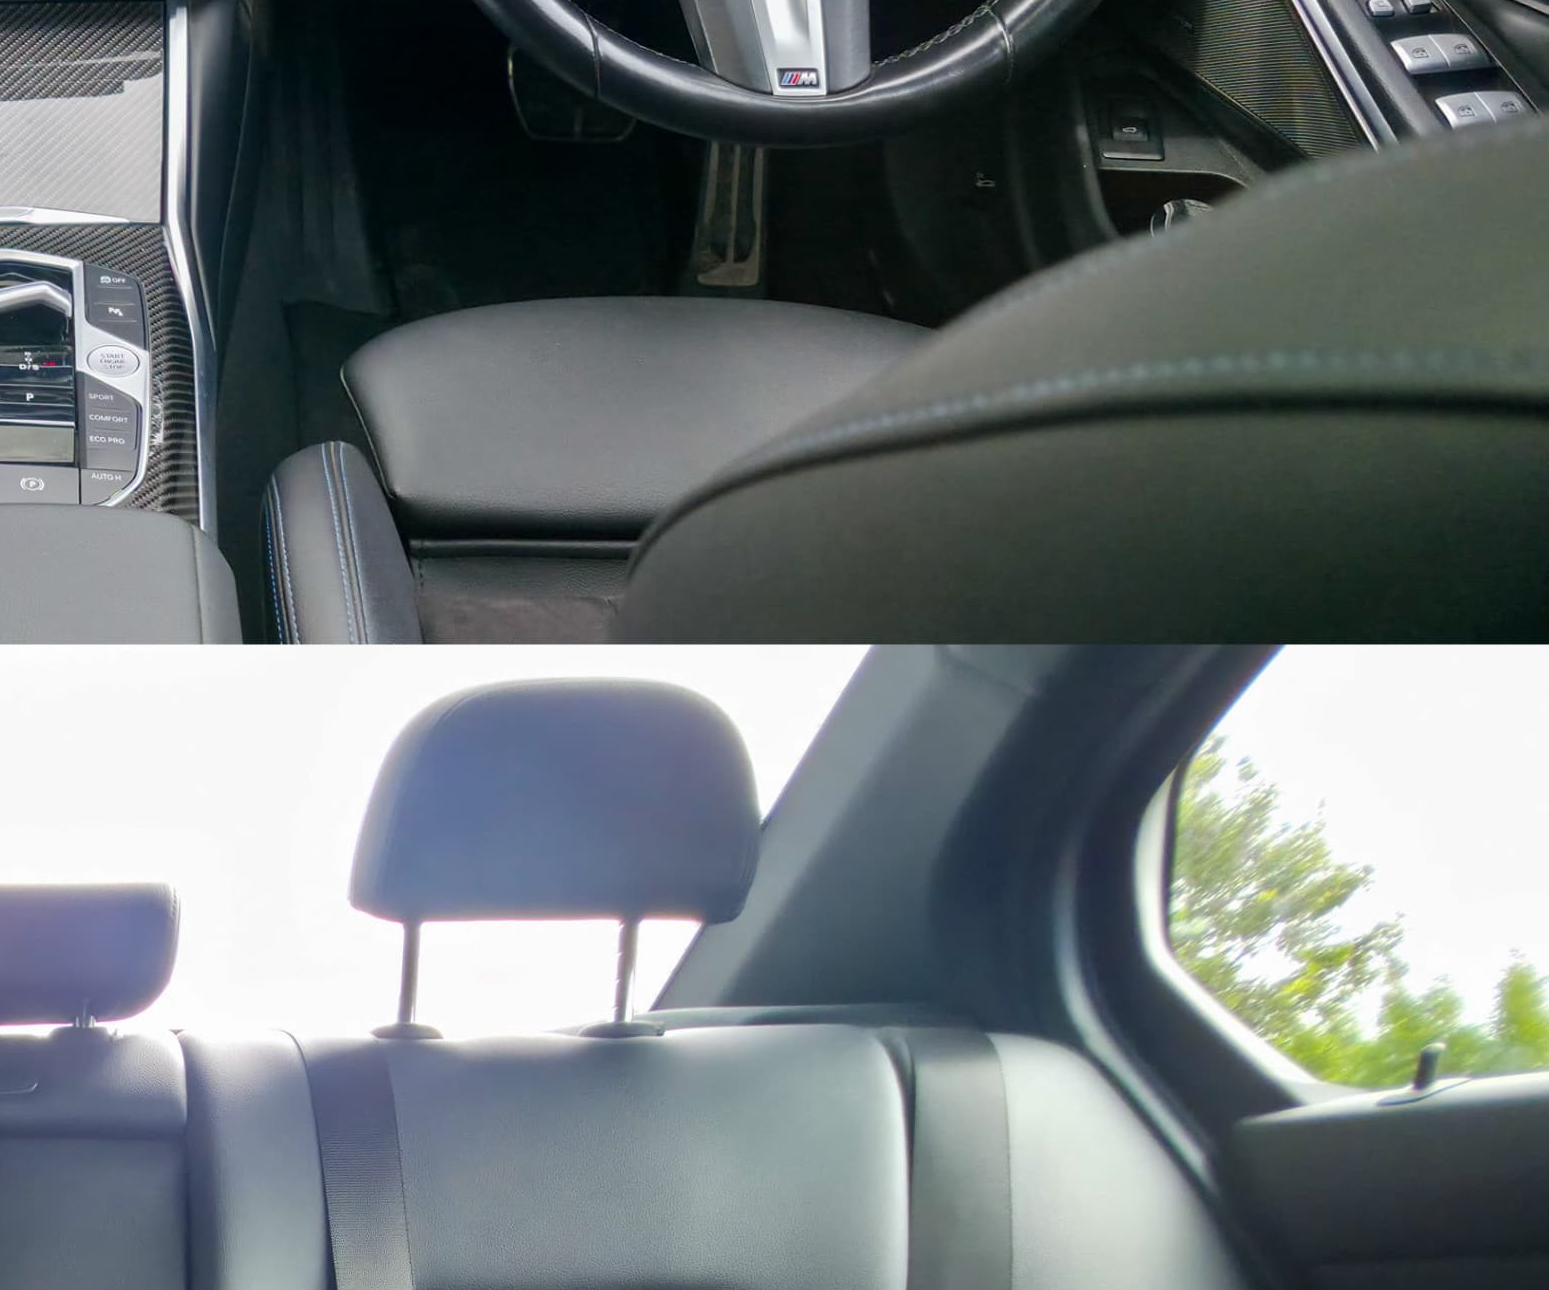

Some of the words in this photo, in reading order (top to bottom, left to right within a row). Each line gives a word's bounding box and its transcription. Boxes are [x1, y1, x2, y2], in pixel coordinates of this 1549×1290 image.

[26, 392, 34, 401] P
[88, 392, 114, 401] SPORT
[88, 414, 129, 424] COMFORT
[89, 435, 107, 443] ECO
[108, 436, 125, 445] PRO
[91, 472, 114, 481] AUTO
[115, 474, 122, 482] H
